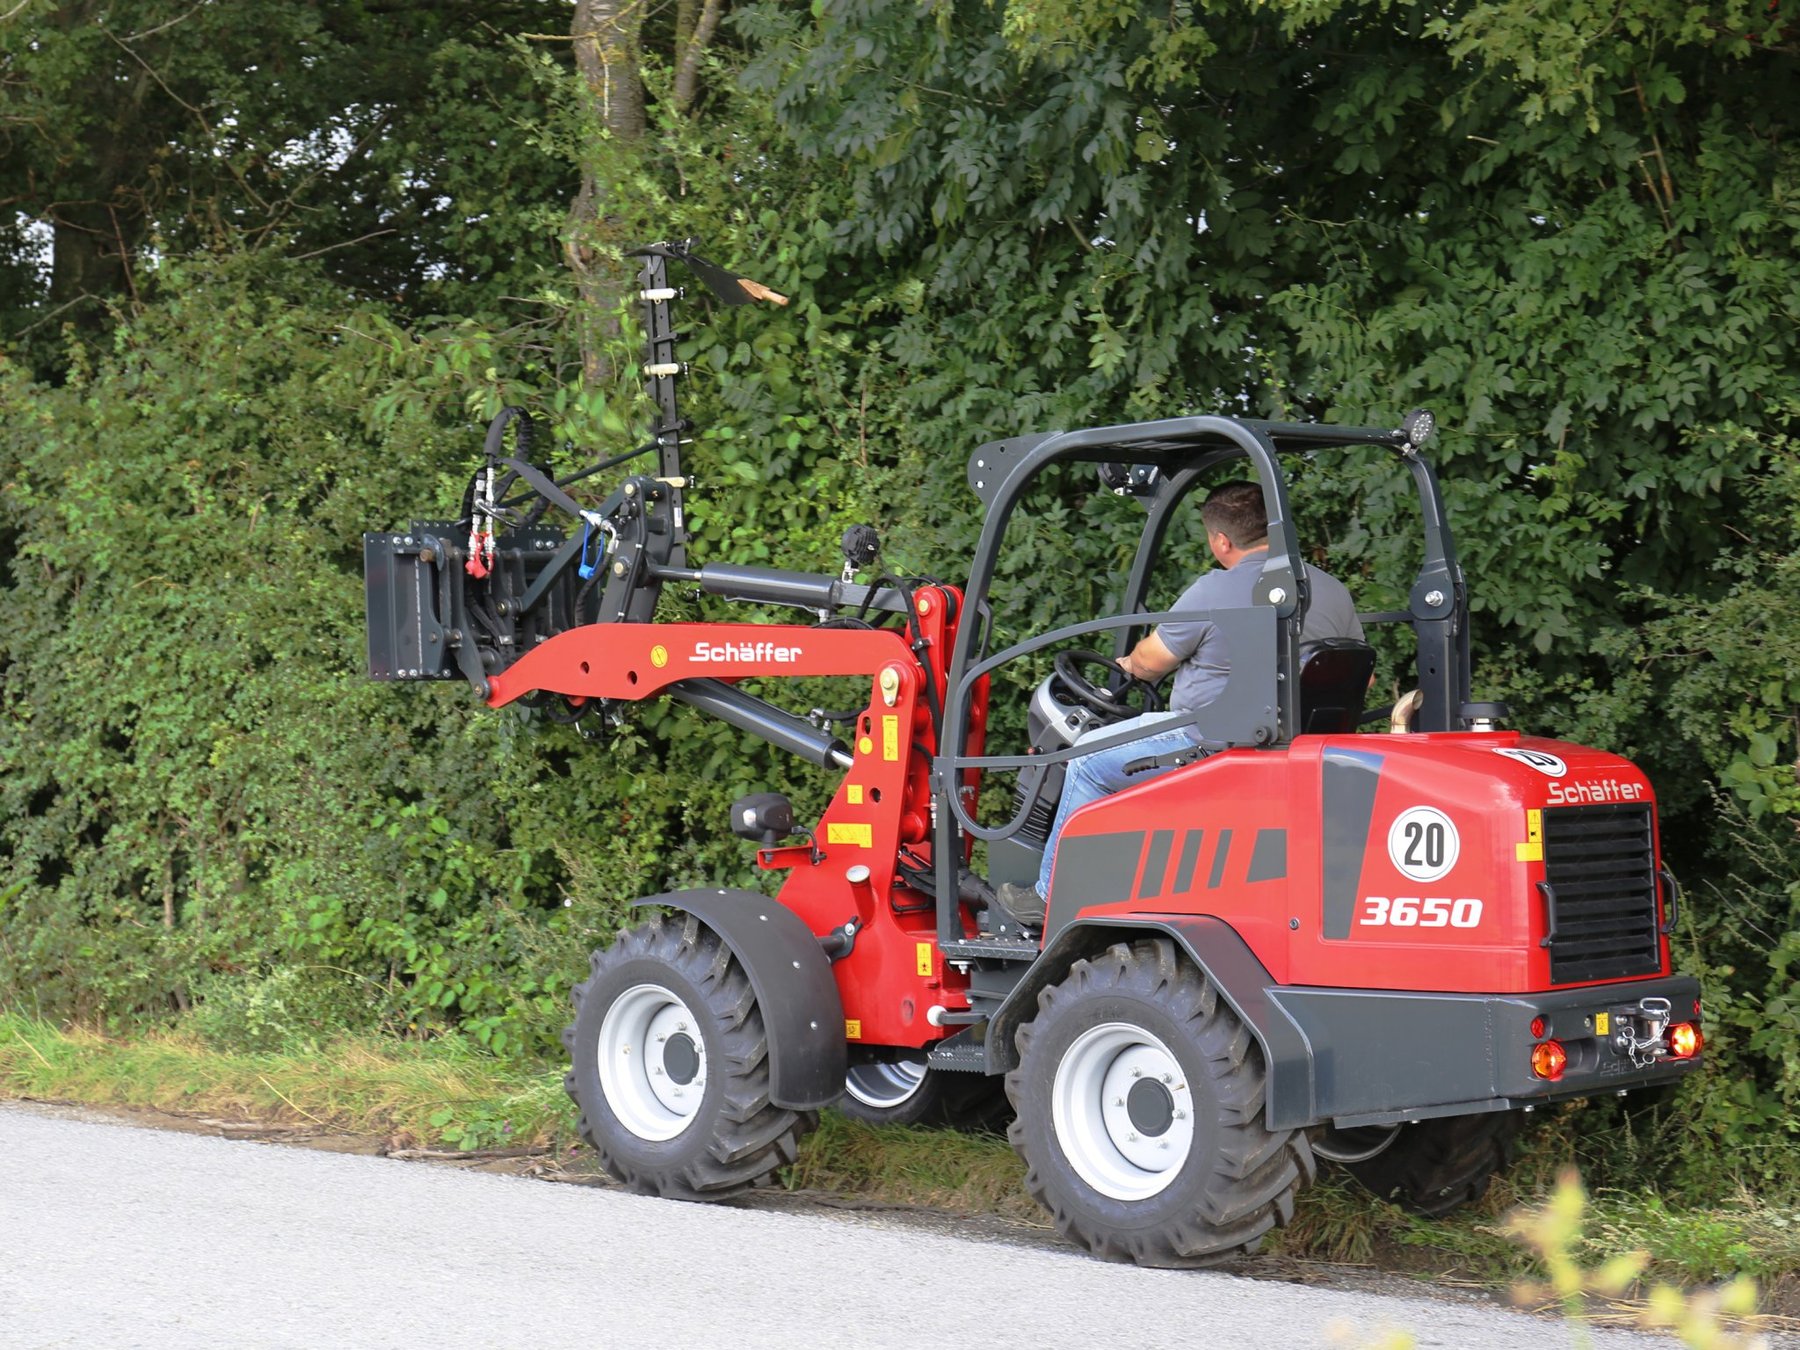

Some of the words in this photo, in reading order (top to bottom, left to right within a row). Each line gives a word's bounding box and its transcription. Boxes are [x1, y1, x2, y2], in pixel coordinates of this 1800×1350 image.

[689, 642, 802, 662] Schäffer
[1547, 779, 1643, 804] Schäffer
[1404, 821, 1445, 867] 20
[1360, 896, 1483, 928] 3650
